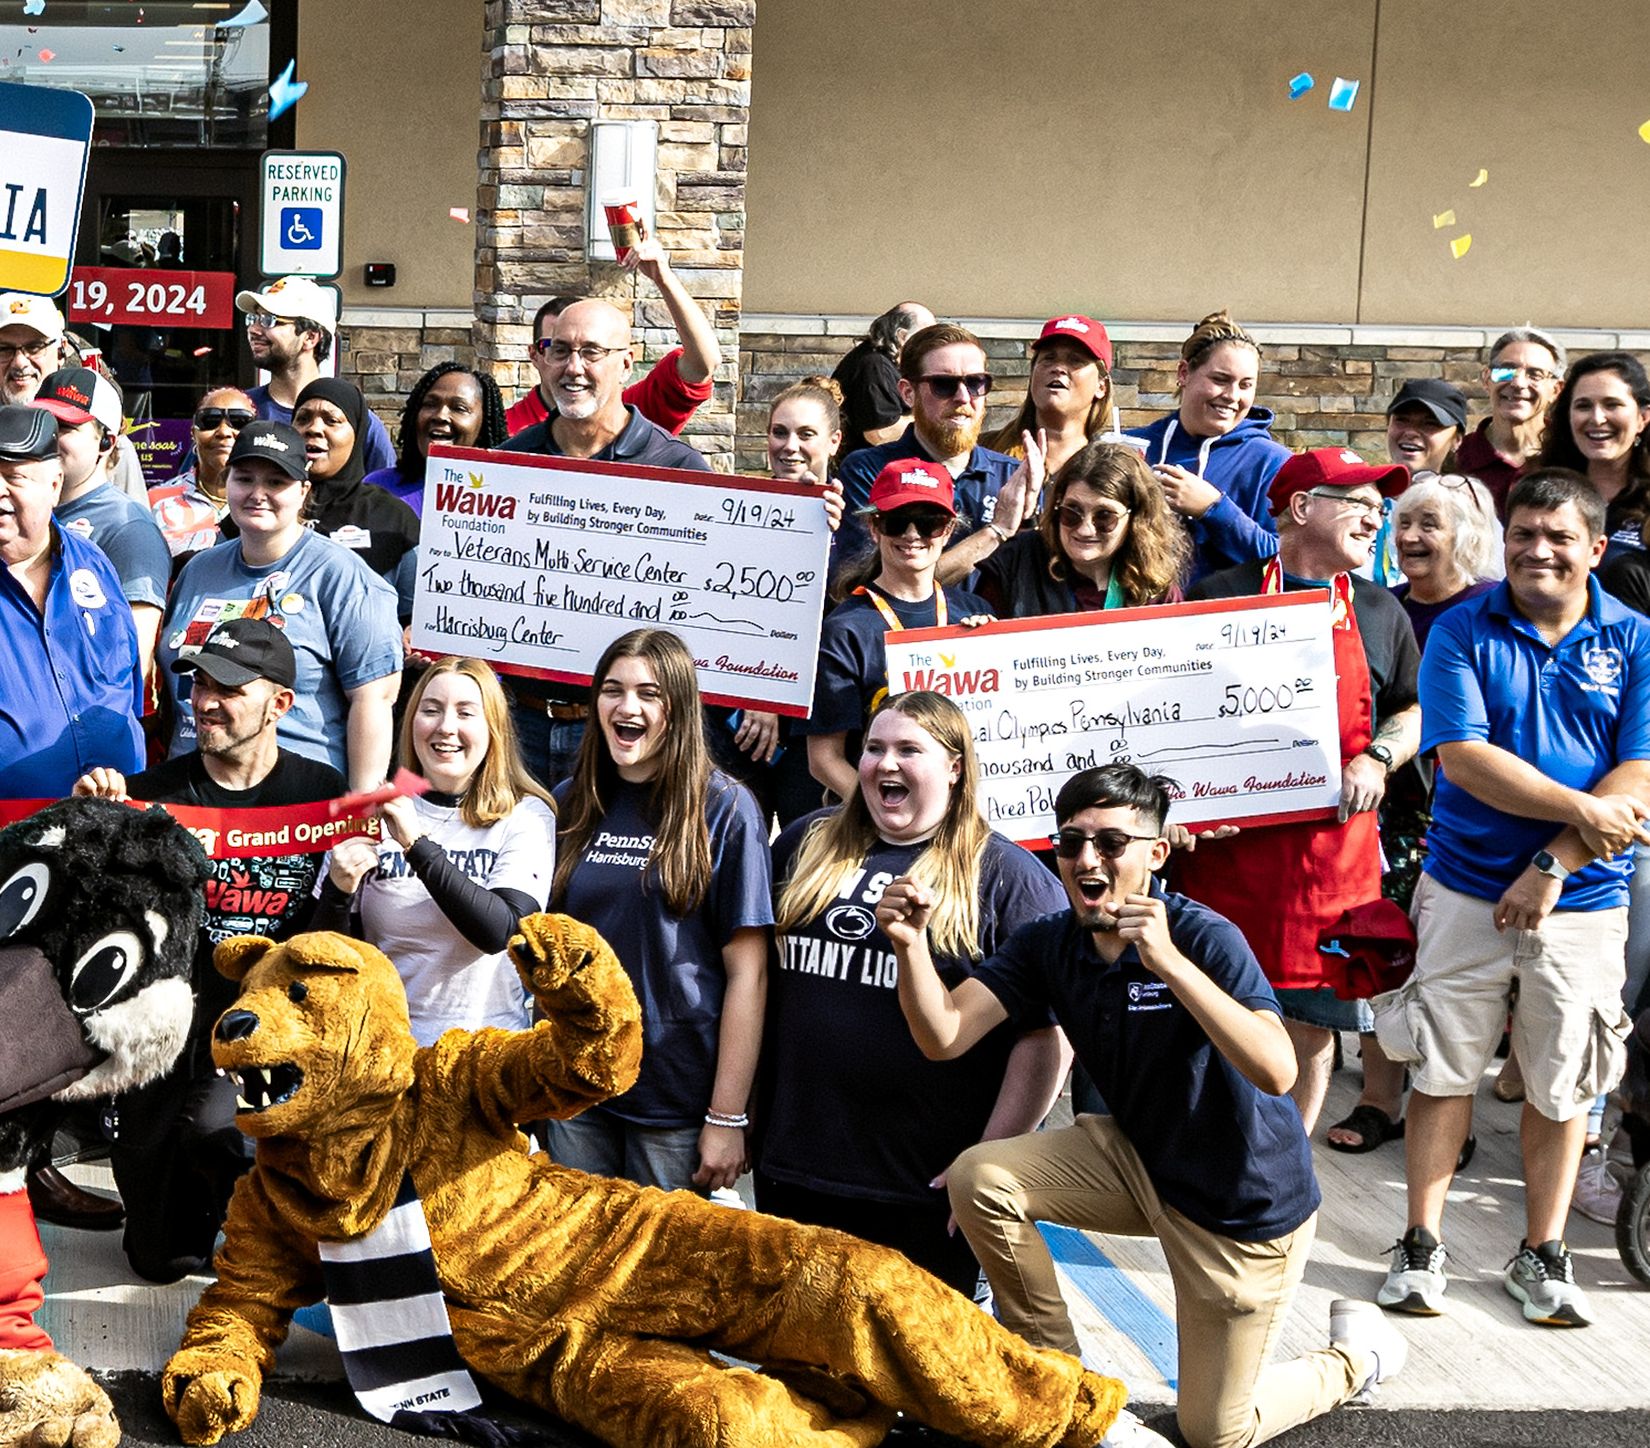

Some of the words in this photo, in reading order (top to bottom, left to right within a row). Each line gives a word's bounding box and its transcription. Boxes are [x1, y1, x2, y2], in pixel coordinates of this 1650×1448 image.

[268, 165, 337, 182] RESERVED
[272, 186, 332, 202] PARKING
[72, 280, 114, 315] 19,
[125, 282, 207, 315] 2024
[444, 468, 464, 484] The
[435, 483, 518, 520] Wawa
[529, 492, 576, 510] Fulfilling
[579, 498, 609, 514] Lives,
[612, 502, 642, 518] Every
[645, 505, 667, 520] Day,
[721, 498, 796, 529] 9/19/24
[442, 514, 505, 534] Foundation
[527, 509, 540, 521] by
[543, 511, 586, 529] Building
[589, 516, 634, 534] Stronger
[637, 522, 708, 541] Communities
[455, 532, 531, 568] Veterans
[635, 552, 689, 584] Center
[422, 563, 454, 592] Two
[459, 569, 526, 605] thousand
[533, 574, 561, 608] five
[563, 584, 626, 616] hundred
[629, 596, 662, 622] and
[437, 605, 508, 652] Harrisburg
[511, 615, 564, 645] Center
[1220, 619, 1286, 648] 9/19/24
[715, 655, 799, 681] Foundation
[908, 654, 932, 668] The
[1013, 658, 1066, 672] Fulfilling
[1070, 653, 1103, 665] Lives,
[1107, 648, 1138, 664] Every
[1143, 646, 1166, 658] Day,
[903, 668, 1000, 697] Wawa
[1015, 677, 1028, 691] by
[1033, 672, 1081, 687] Building
[1085, 666, 1133, 682] Stronger
[1137, 660, 1213, 676] Communities
[1066, 749, 1097, 771] and
[1192, 782, 1239, 798] Wawa
[1243, 772, 1328, 795] Foundation
[987, 795, 1026, 821] Area
[1026, 785, 1057, 814] Pol
[227, 825, 290, 850] Grand
[294, 814, 381, 844] Opening
[594, 832, 655, 851] PennSt
[585, 850, 650, 871] Harrisburg
[859, 948, 898, 990] LIO
[415, 1387, 451, 1406] STATE
